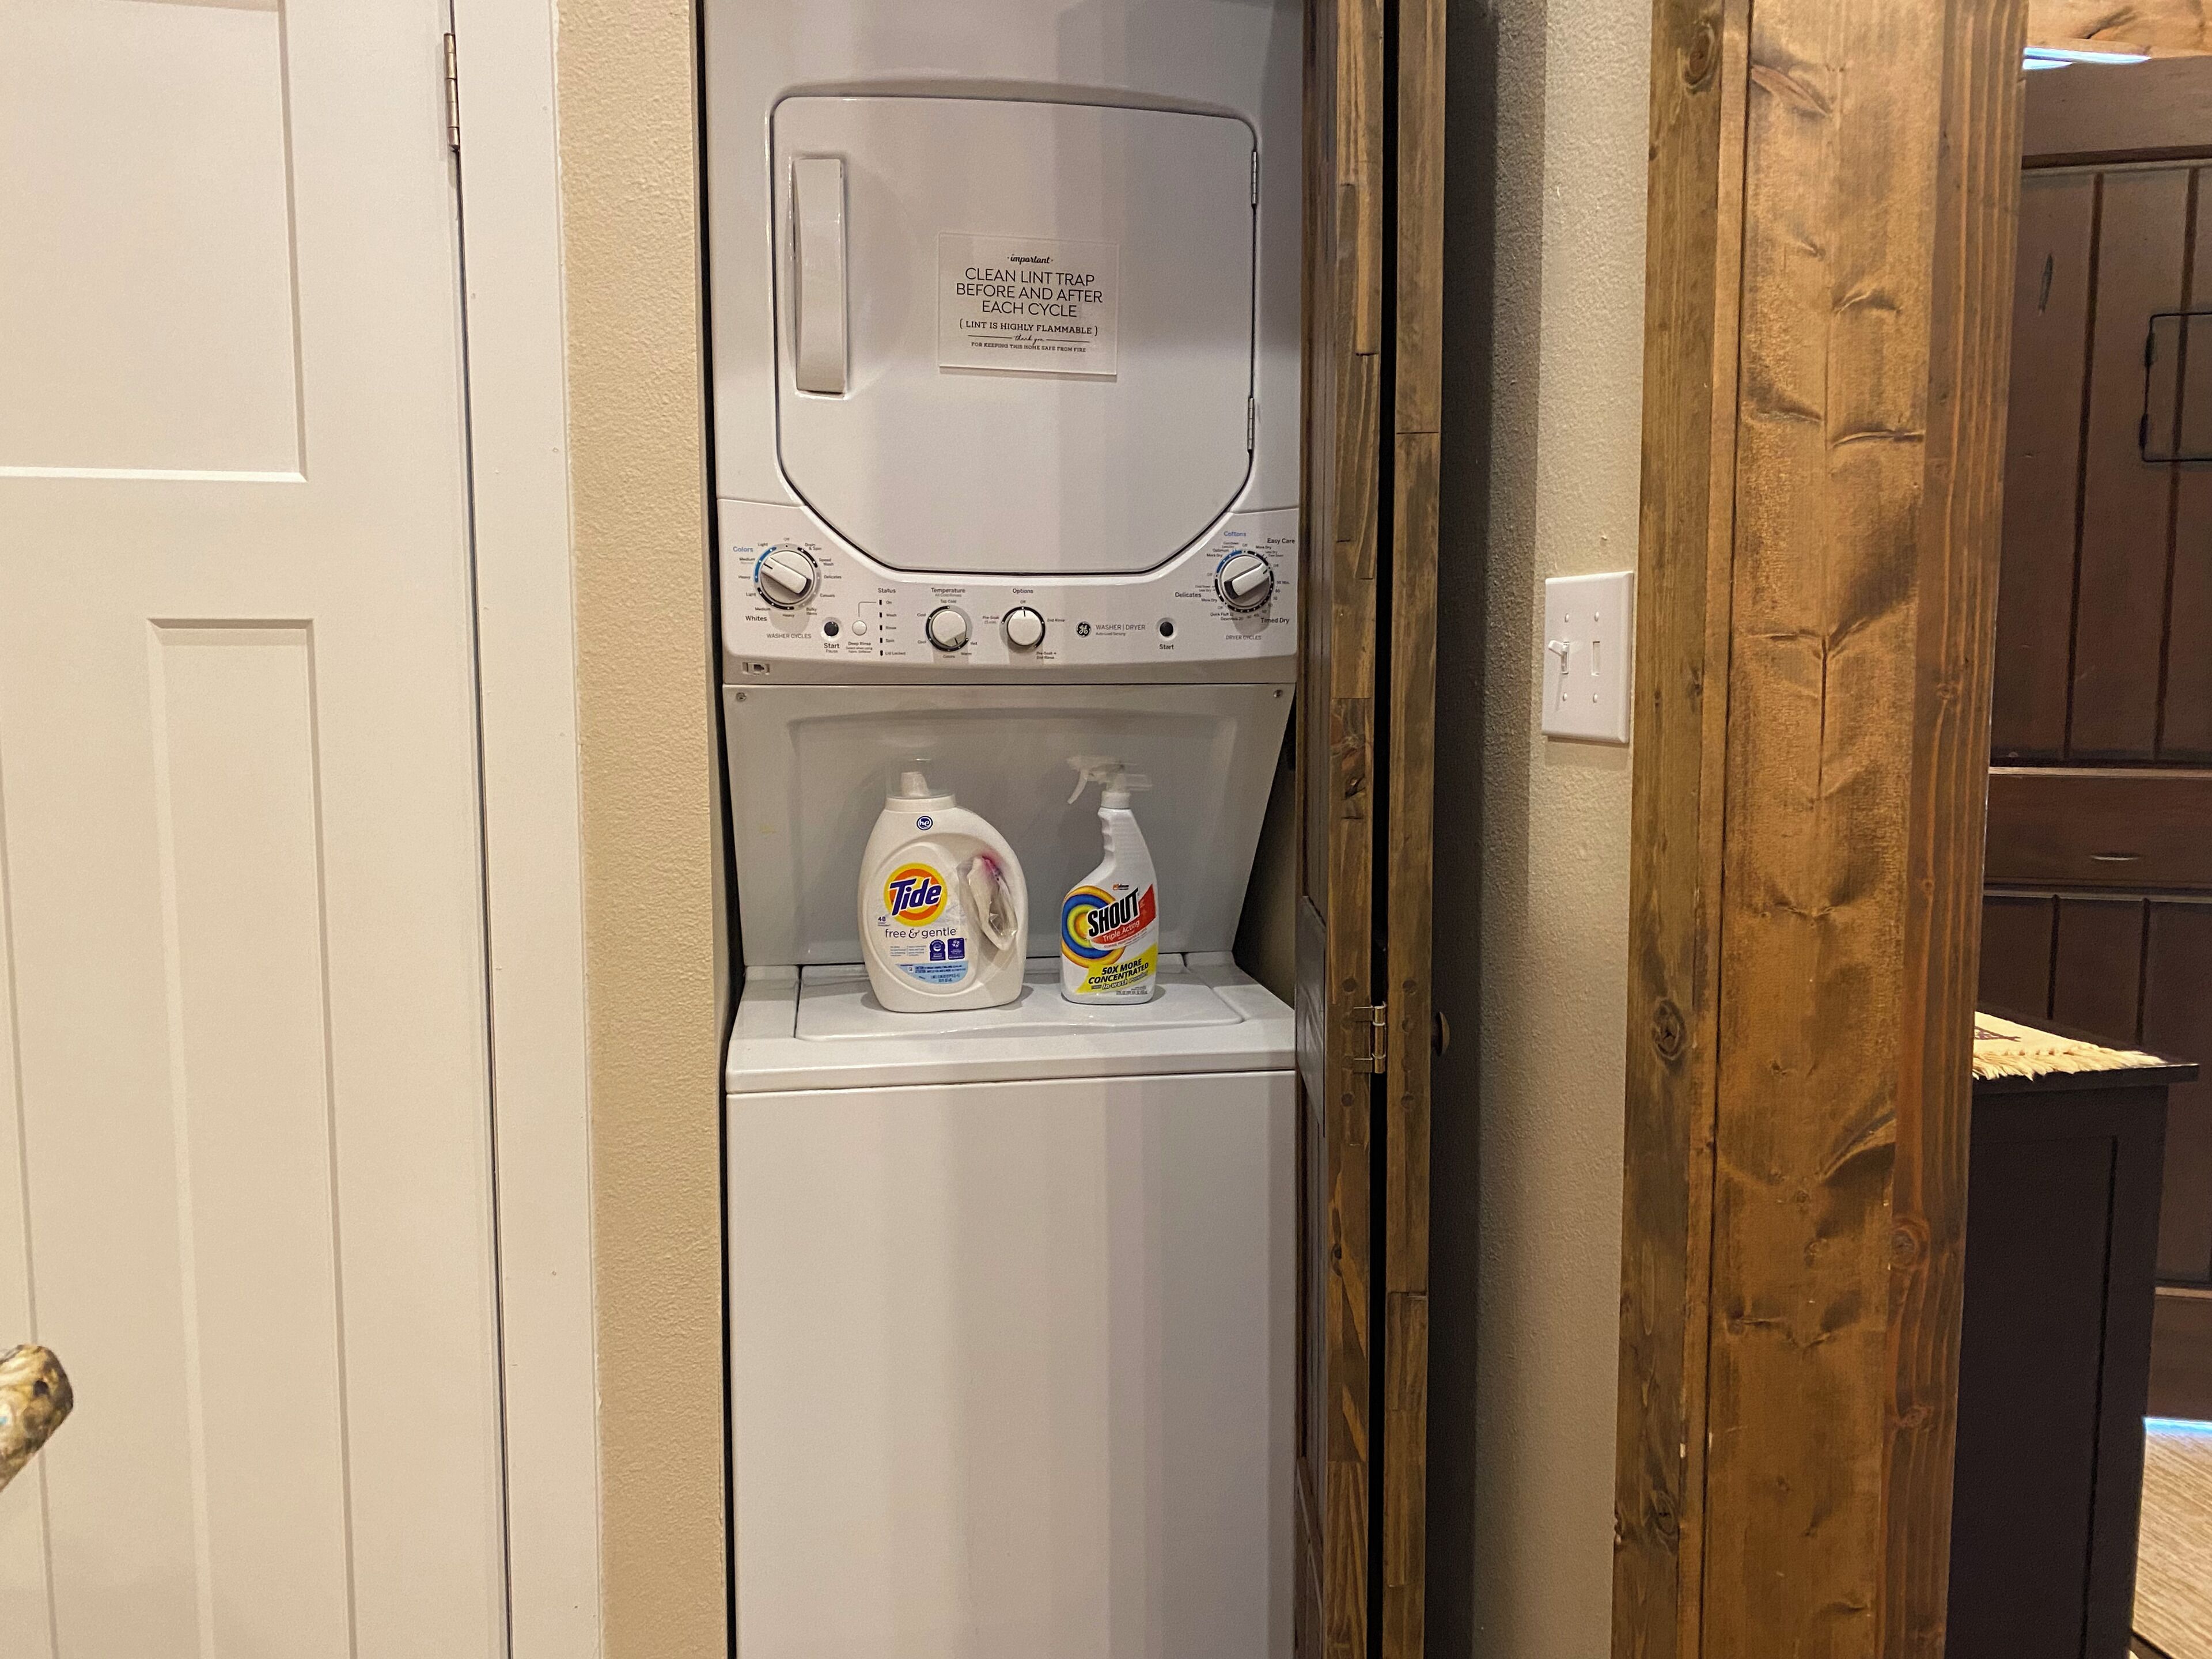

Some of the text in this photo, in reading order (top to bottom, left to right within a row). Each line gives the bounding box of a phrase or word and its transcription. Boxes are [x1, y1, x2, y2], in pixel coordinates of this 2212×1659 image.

[1010, 253, 1050, 265] important
[965, 267, 1094, 286] CLEAN LINT TRAP
[957, 283, 1103, 303] BEFORE AND AFTER
[982, 300, 1077, 317] EACH CYCLE
[1001, 323, 1034, 331] HIGHLY
[1036, 325, 1092, 334] FLAMMABLE
[889, 877, 942, 916] Tide
[1088, 887, 1139, 937] SHOUT
[885, 927, 956, 939] free & gentle
[1103, 931, 1120, 942] Triple
[1122, 921, 1140, 933] Acting
[1088, 962, 1149, 984] CONCENTRATED
[1101, 959, 1142, 975] 50X MORE
